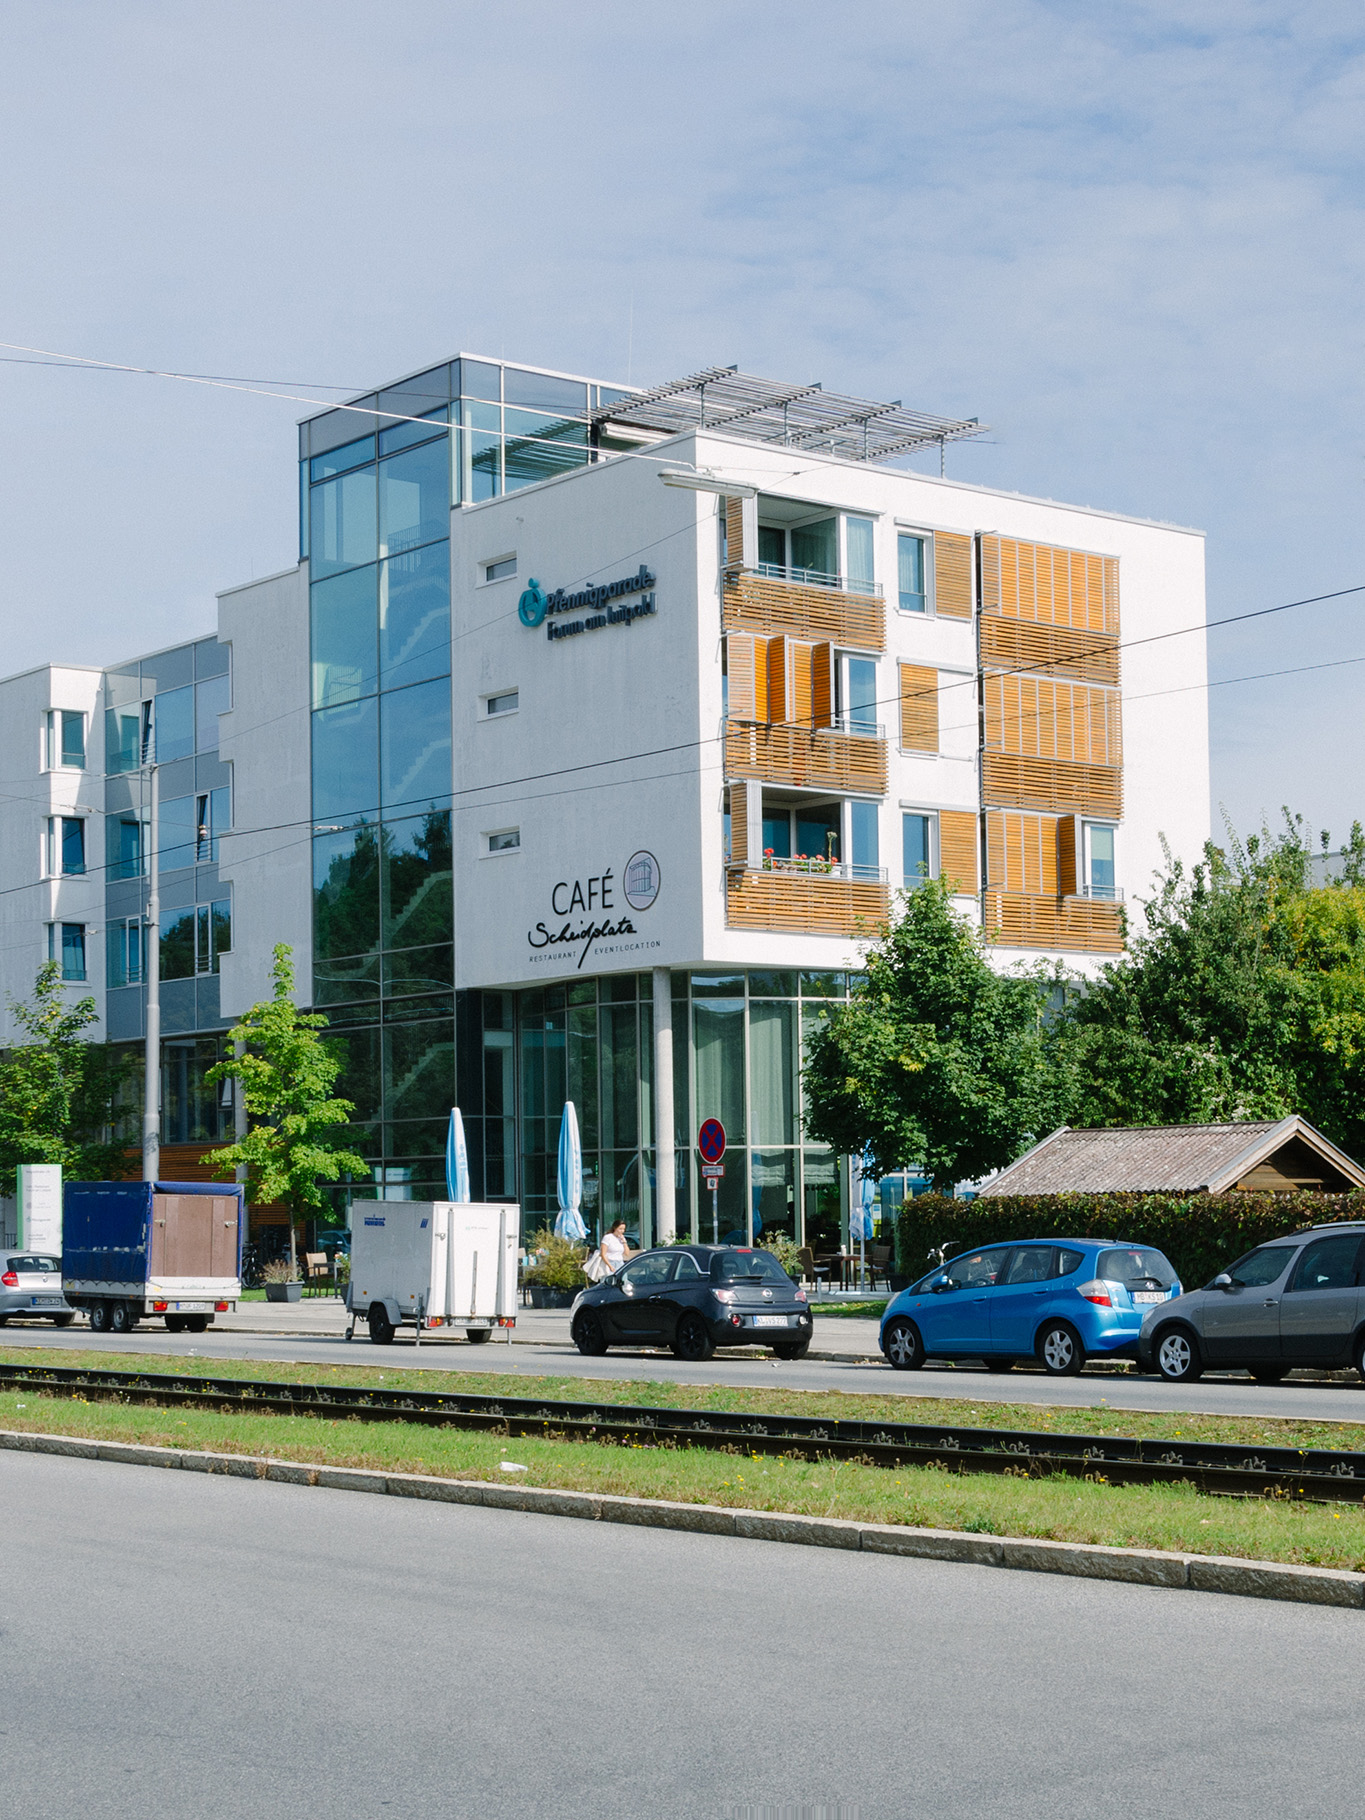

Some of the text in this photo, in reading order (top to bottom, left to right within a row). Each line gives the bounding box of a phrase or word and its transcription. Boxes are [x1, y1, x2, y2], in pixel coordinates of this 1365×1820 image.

[546, 564, 656, 614] Pfennigparade
[547, 620, 584, 641] Forum
[584, 614, 606, 630] am
[551, 867, 614, 916] CAFÉ
[528, 916, 637, 969] Scheidplatz
[529, 940, 662, 963] RESTAURANT EVENTLOCATION
